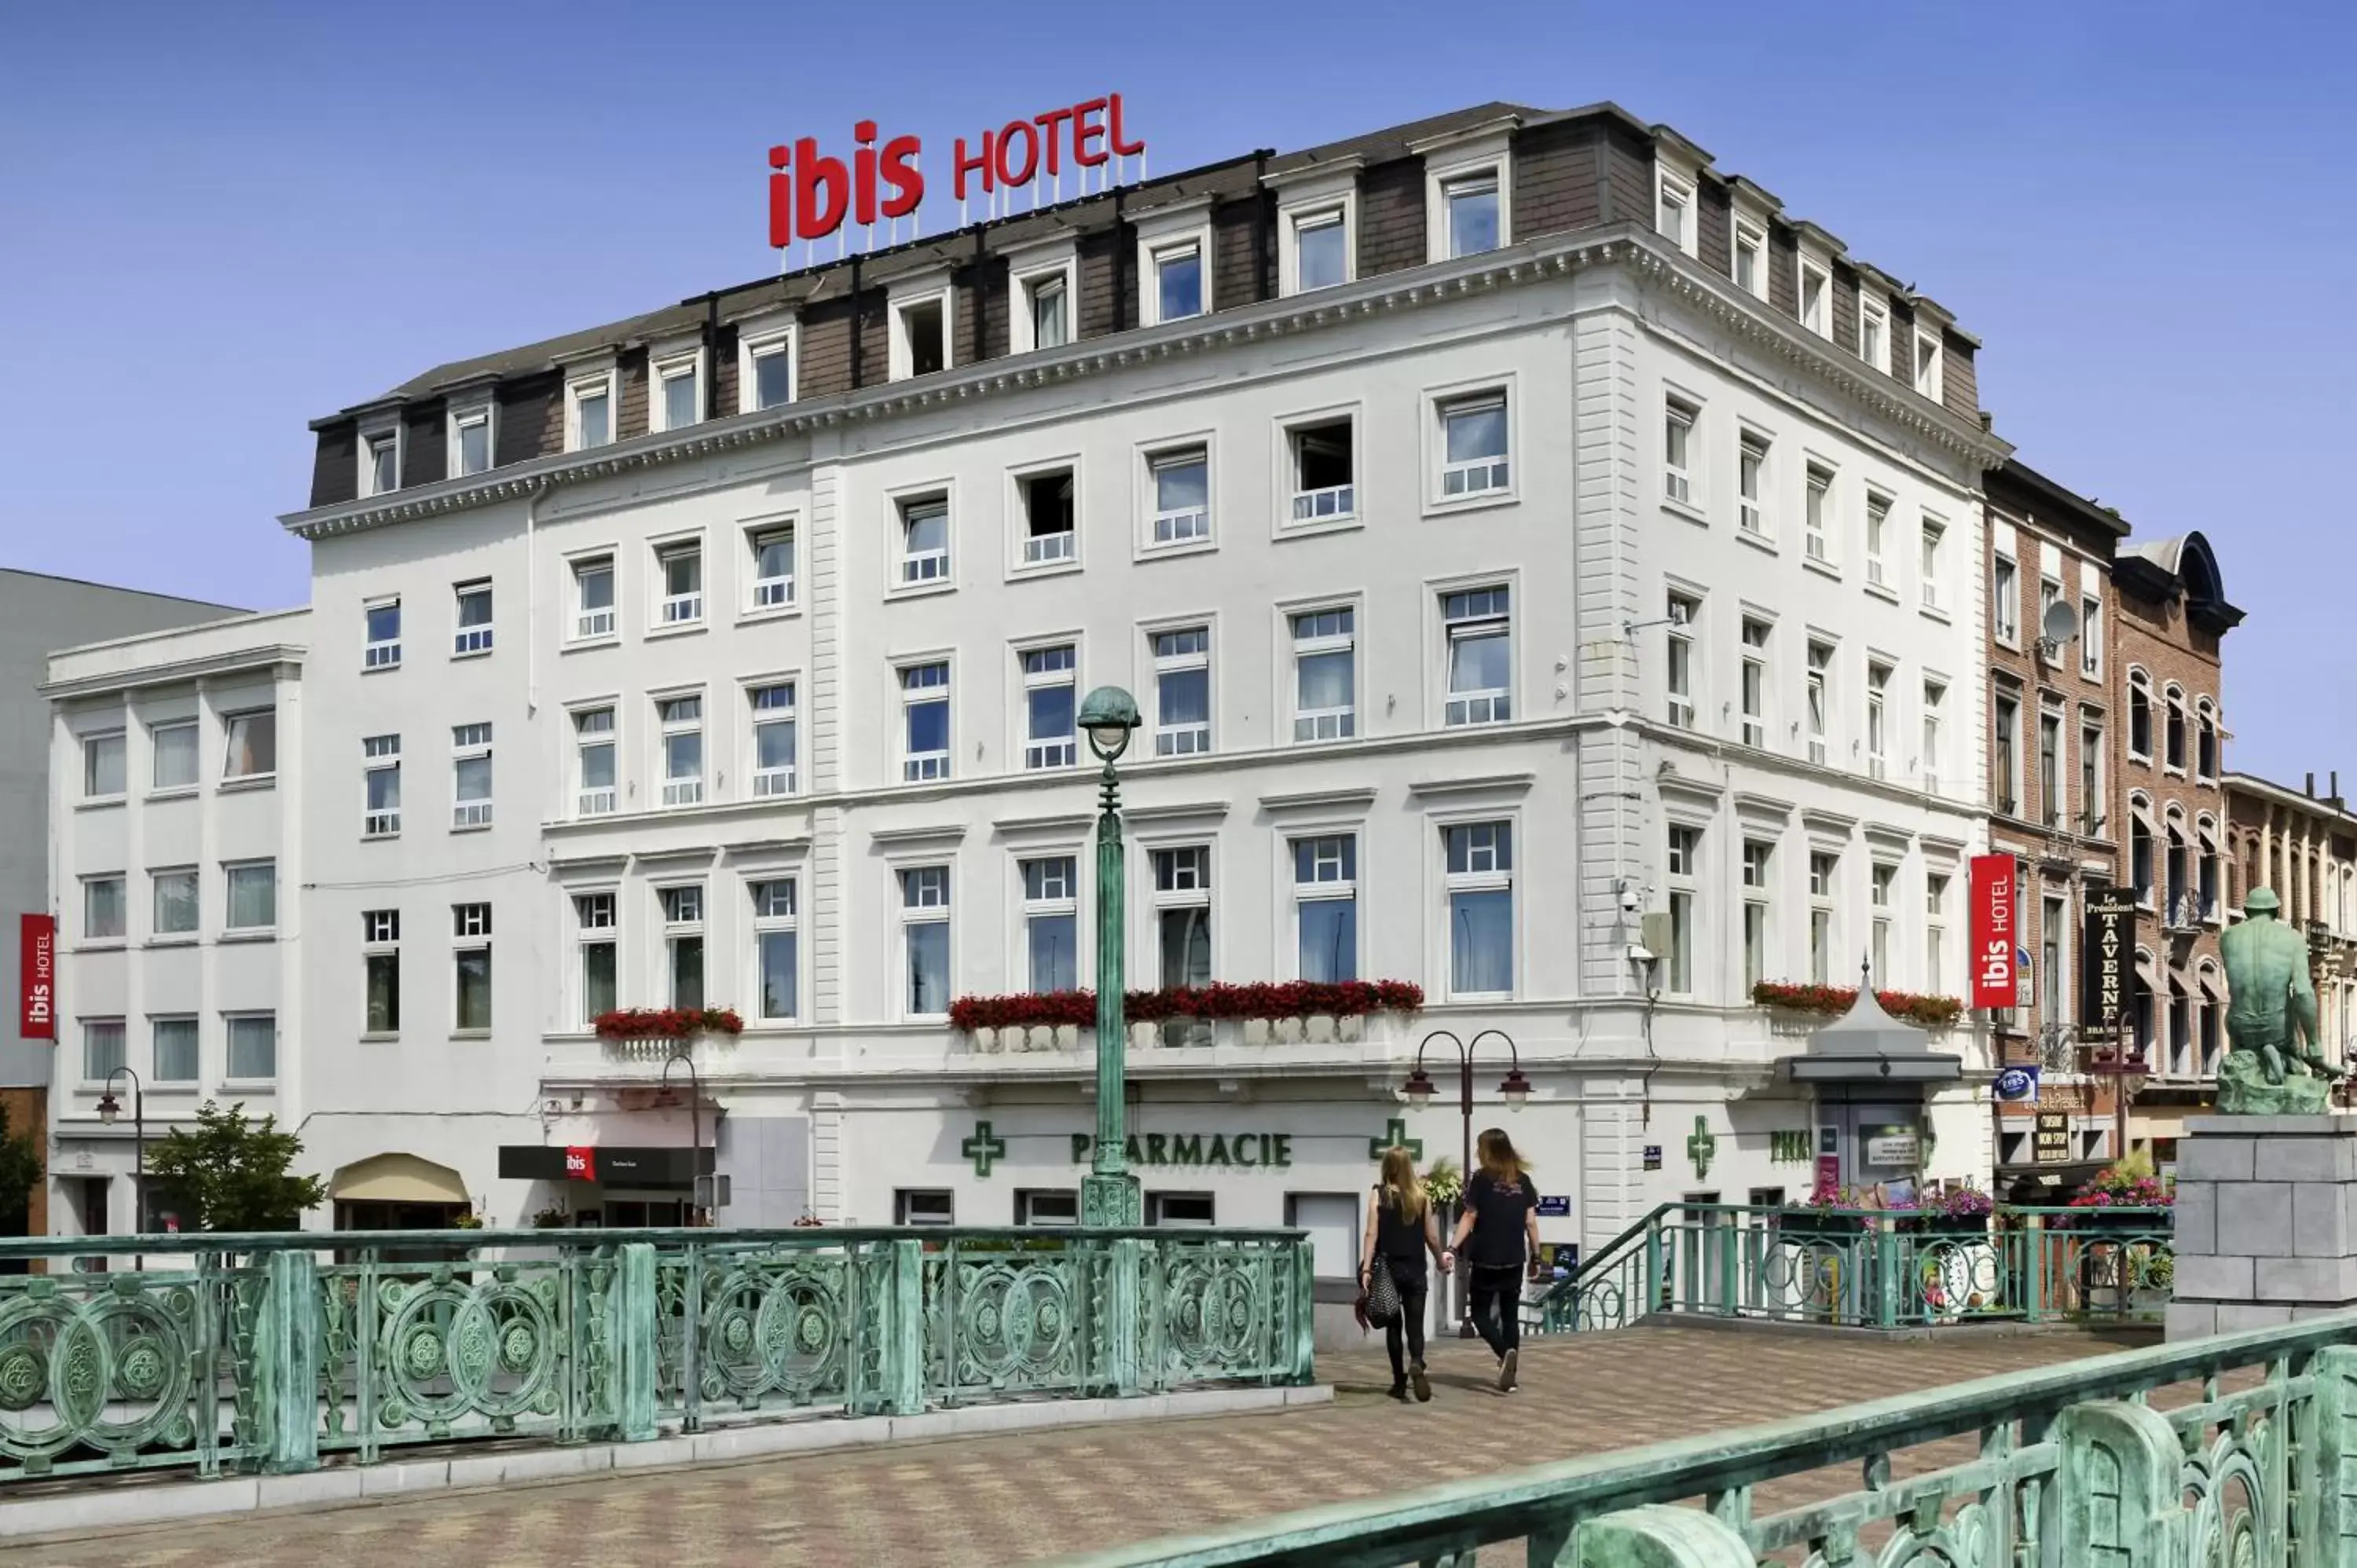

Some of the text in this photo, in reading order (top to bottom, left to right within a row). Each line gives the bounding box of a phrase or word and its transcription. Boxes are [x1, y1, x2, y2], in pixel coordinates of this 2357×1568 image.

[769, 93, 1145, 248] ibis HOTEL
[29, 932, 49, 1024] ibis HOTEL
[1982, 874, 2009, 987] ibis HOTEL
[2102, 914, 2120, 1020] TAVERNE
[566, 1154, 585, 1170] ibis
[1071, 1133, 1292, 1167] PARMACIE
